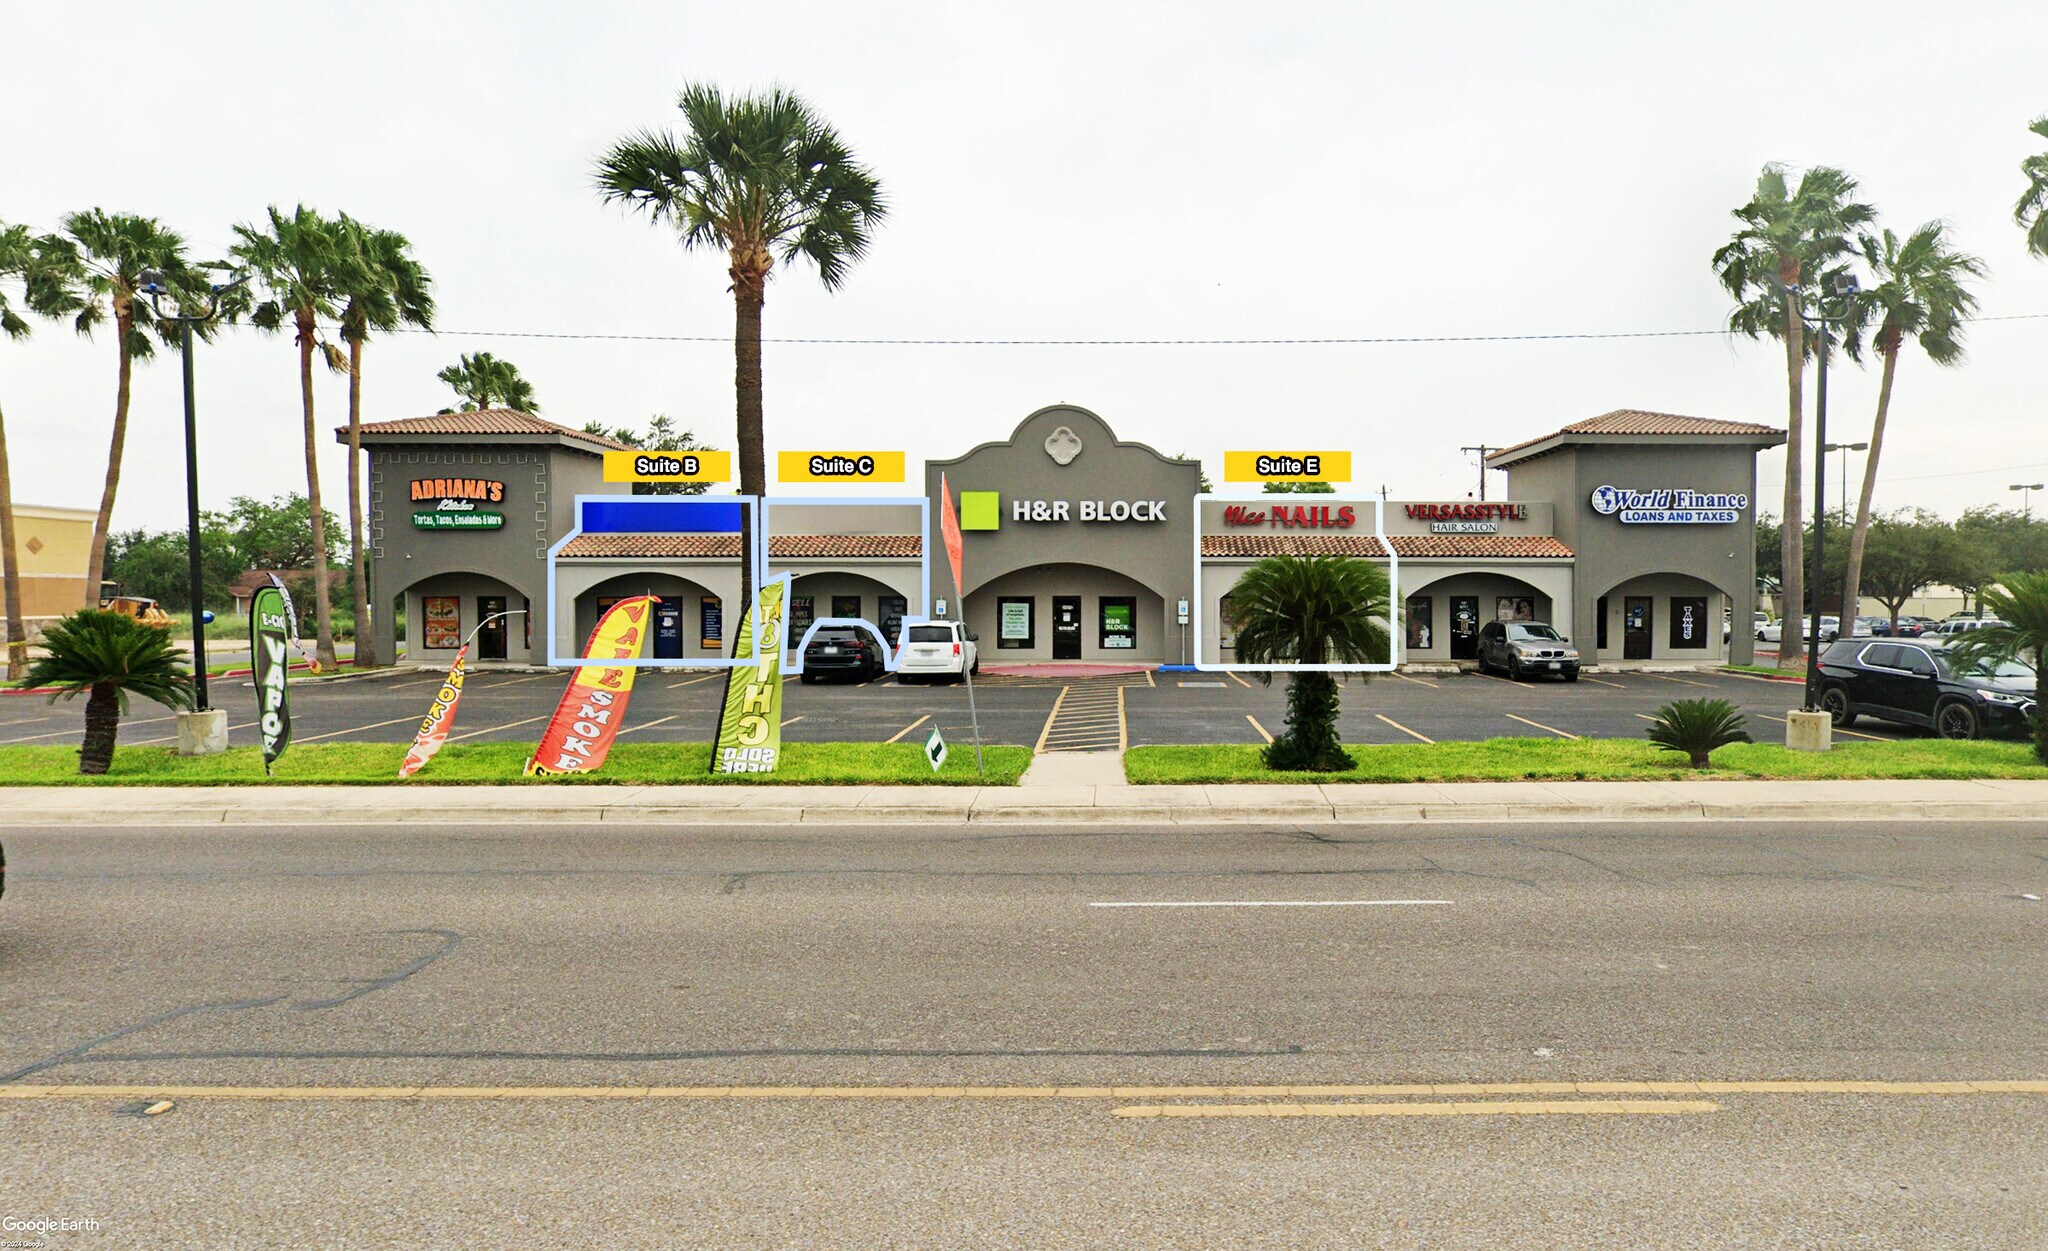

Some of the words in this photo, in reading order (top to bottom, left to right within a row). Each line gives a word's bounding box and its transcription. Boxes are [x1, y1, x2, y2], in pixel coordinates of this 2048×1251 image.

[411, 478, 503, 502] ADRIANA'S
[1614, 489, 1670, 508] World
[1675, 490, 1746, 508] Finance
[413, 515, 435, 527] Tortas,
[436, 515, 454, 527] Tacos,
[487, 515, 501, 525] More
[1013, 500, 1070, 521] H&R
[1080, 500, 1167, 521] BLOCK
[1224, 505, 1266, 527] Nice
[1271, 505, 1356, 528] NAILS
[1404, 503, 1527, 520] VERSASSTYLE
[1625, 512, 1665, 521] LOANS
[1668, 512, 1693, 521] AND
[1696, 512, 1734, 521] TAXES
[1432, 523, 1458, 532] HAIR
[1461, 523, 1497, 532] SALON
[1683, 606, 1692, 639] TAXES
[262, 634, 286, 755] VAPOR
[554, 690, 614, 770] SMOKE
